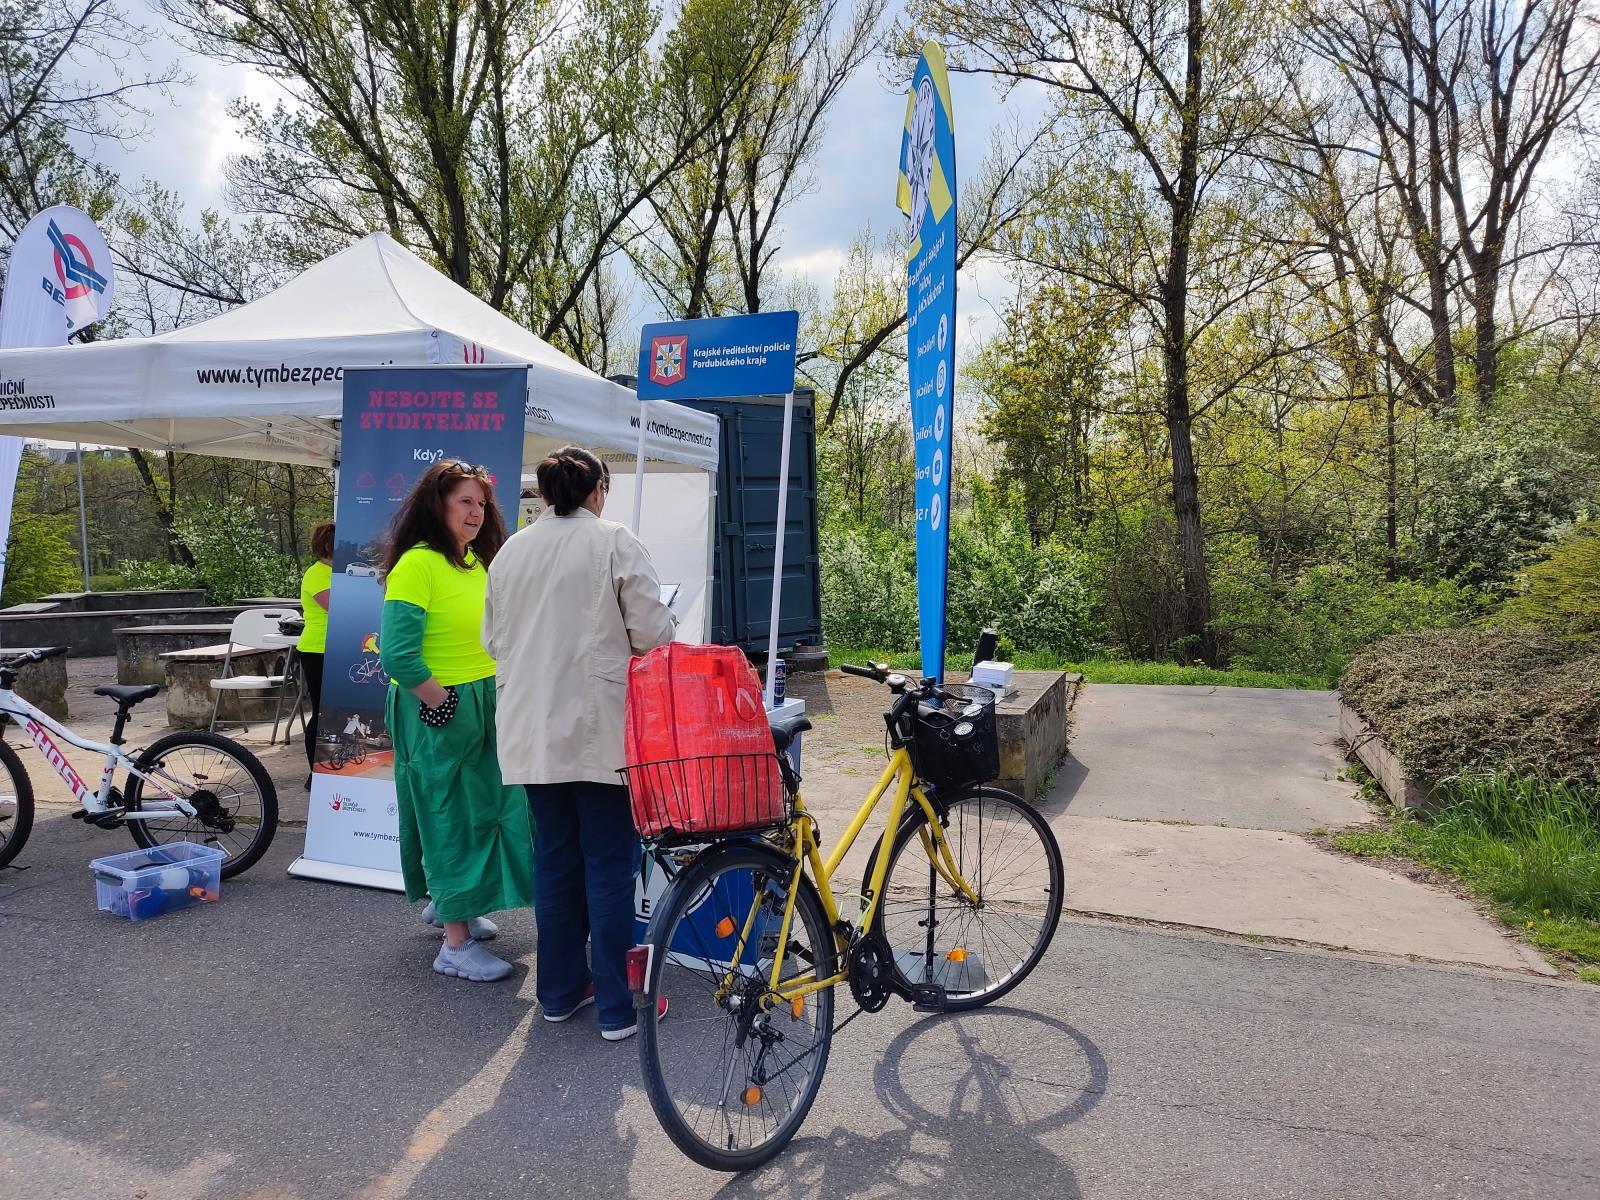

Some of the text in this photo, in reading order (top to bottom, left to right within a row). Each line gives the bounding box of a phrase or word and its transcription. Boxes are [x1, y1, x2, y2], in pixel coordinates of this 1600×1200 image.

[693, 341, 791, 359] Krajské ředitelství policie
[692, 355, 767, 368] Pardubického kraje
[197, 363, 343, 388] www.tymbezpec
[0, 394, 55, 410] PEČNOSTI
[368, 390, 498, 409] NEBOJTE SE
[360, 411, 505, 431] ZVIDITELNIT
[413, 448, 444, 464] Kdy?
